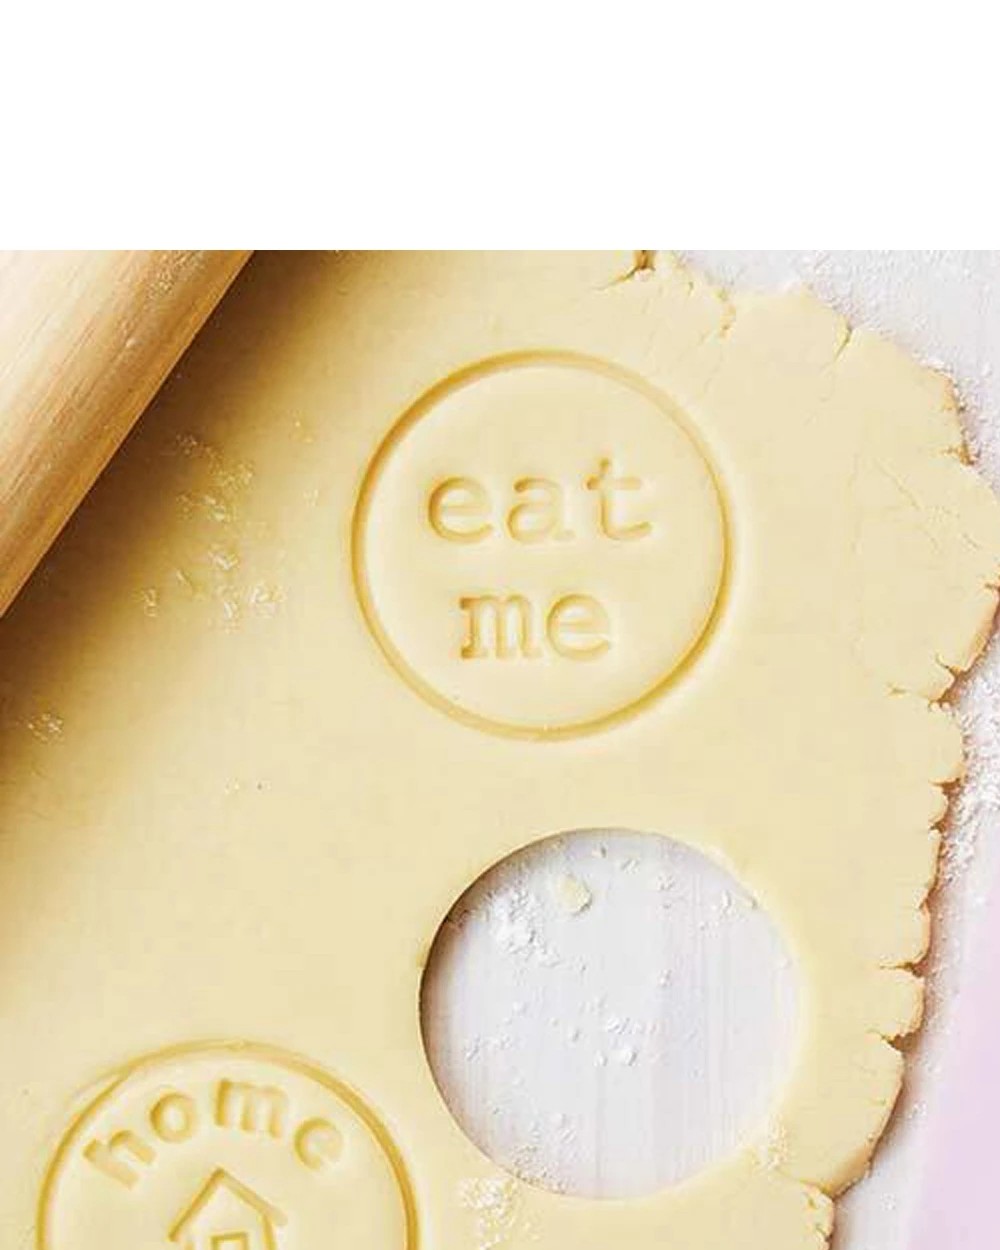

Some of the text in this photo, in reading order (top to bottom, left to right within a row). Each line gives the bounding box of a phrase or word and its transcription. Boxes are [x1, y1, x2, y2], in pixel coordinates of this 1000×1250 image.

[428, 457, 653, 544] eat
[457, 593, 611, 661] me
[83, 1078, 345, 1190] home
